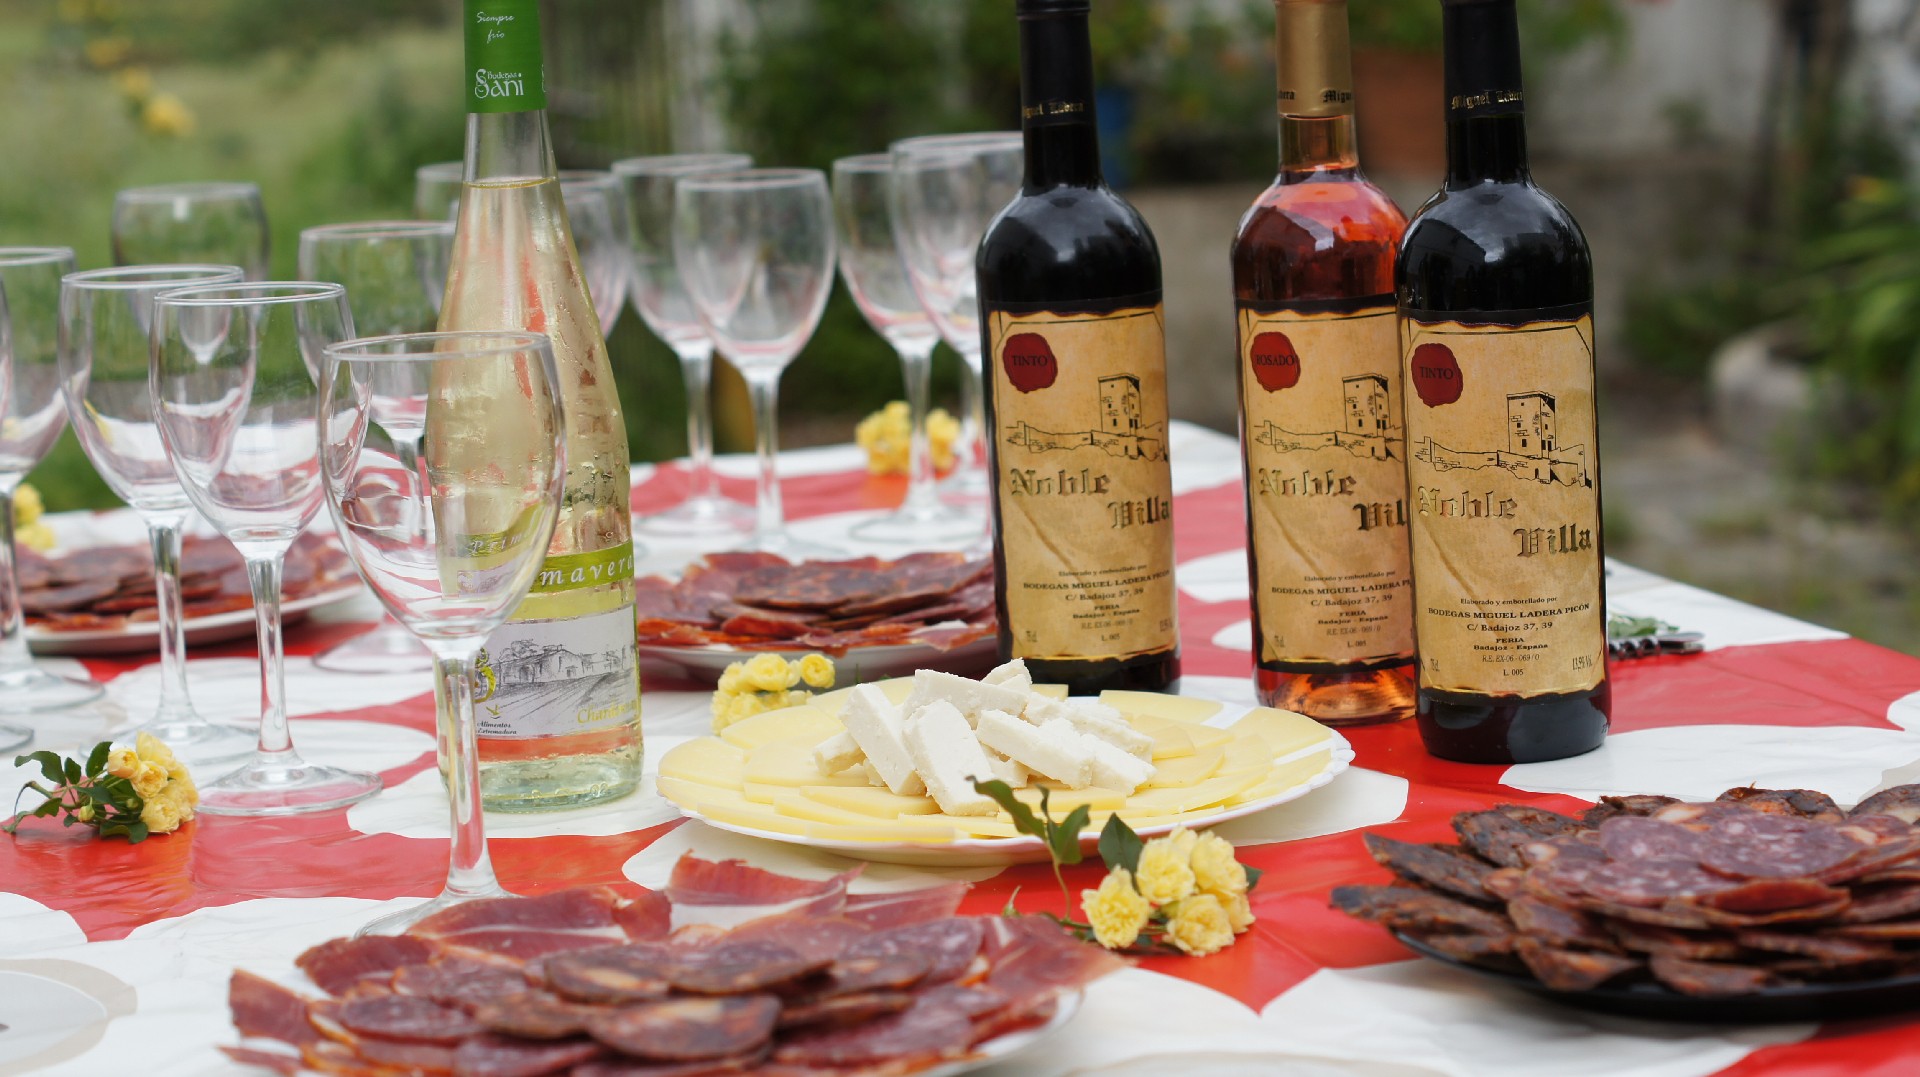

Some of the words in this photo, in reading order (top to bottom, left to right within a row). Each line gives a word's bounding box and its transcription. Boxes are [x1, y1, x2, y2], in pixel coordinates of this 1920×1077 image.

[476, 12, 514, 26] Siempre
[475, 68, 524, 98] Sani
[1452, 92, 1490, 110] Miguel
[1011, 354, 1048, 366] TINTO
[1256, 354, 1295, 366] ROSADO
[1419, 366, 1454, 380] TINTO
[1010, 468, 1111, 496] Noble
[1258, 468, 1357, 496] Noble
[1418, 485, 1518, 520] Noble
[1108, 496, 1170, 530] Villa
[1352, 498, 1406, 531] Vil
[1512, 522, 1592, 558] Villa
[1024, 582, 1069, 590] BODEGAS
[1072, 580, 1114, 589] MIGUEL
[1115, 574, 1151, 586] LADERA
[1272, 586, 1314, 594] BODEGAS
[1317, 586, 1358, 594] MIGUEL
[1361, 582, 1400, 592] LADERA
[1065, 594, 1076, 602] C/
[1080, 592, 1116, 602] Badajoz
[1134, 588, 1144, 596] 39
[1325, 599, 1362, 607] Badajoz
[1364, 596, 1379, 604] 37,
[1382, 594, 1392, 602] 39
[1502, 596, 1546, 606] embotellado
[1359, 615, 1388, 623] España
[1428, 608, 1471, 618] BODEGAS
[1520, 608, 1563, 618] LADERA
[1466, 623, 1478, 632] C/
[1481, 624, 1520, 633] Badajoz
[1523, 624, 1539, 632] 37,
[1473, 644, 1508, 652] Badajoz
[1516, 643, 1548, 651] España
[1512, 668, 1524, 676] 005
[476, 720, 512, 728] Alimentos
